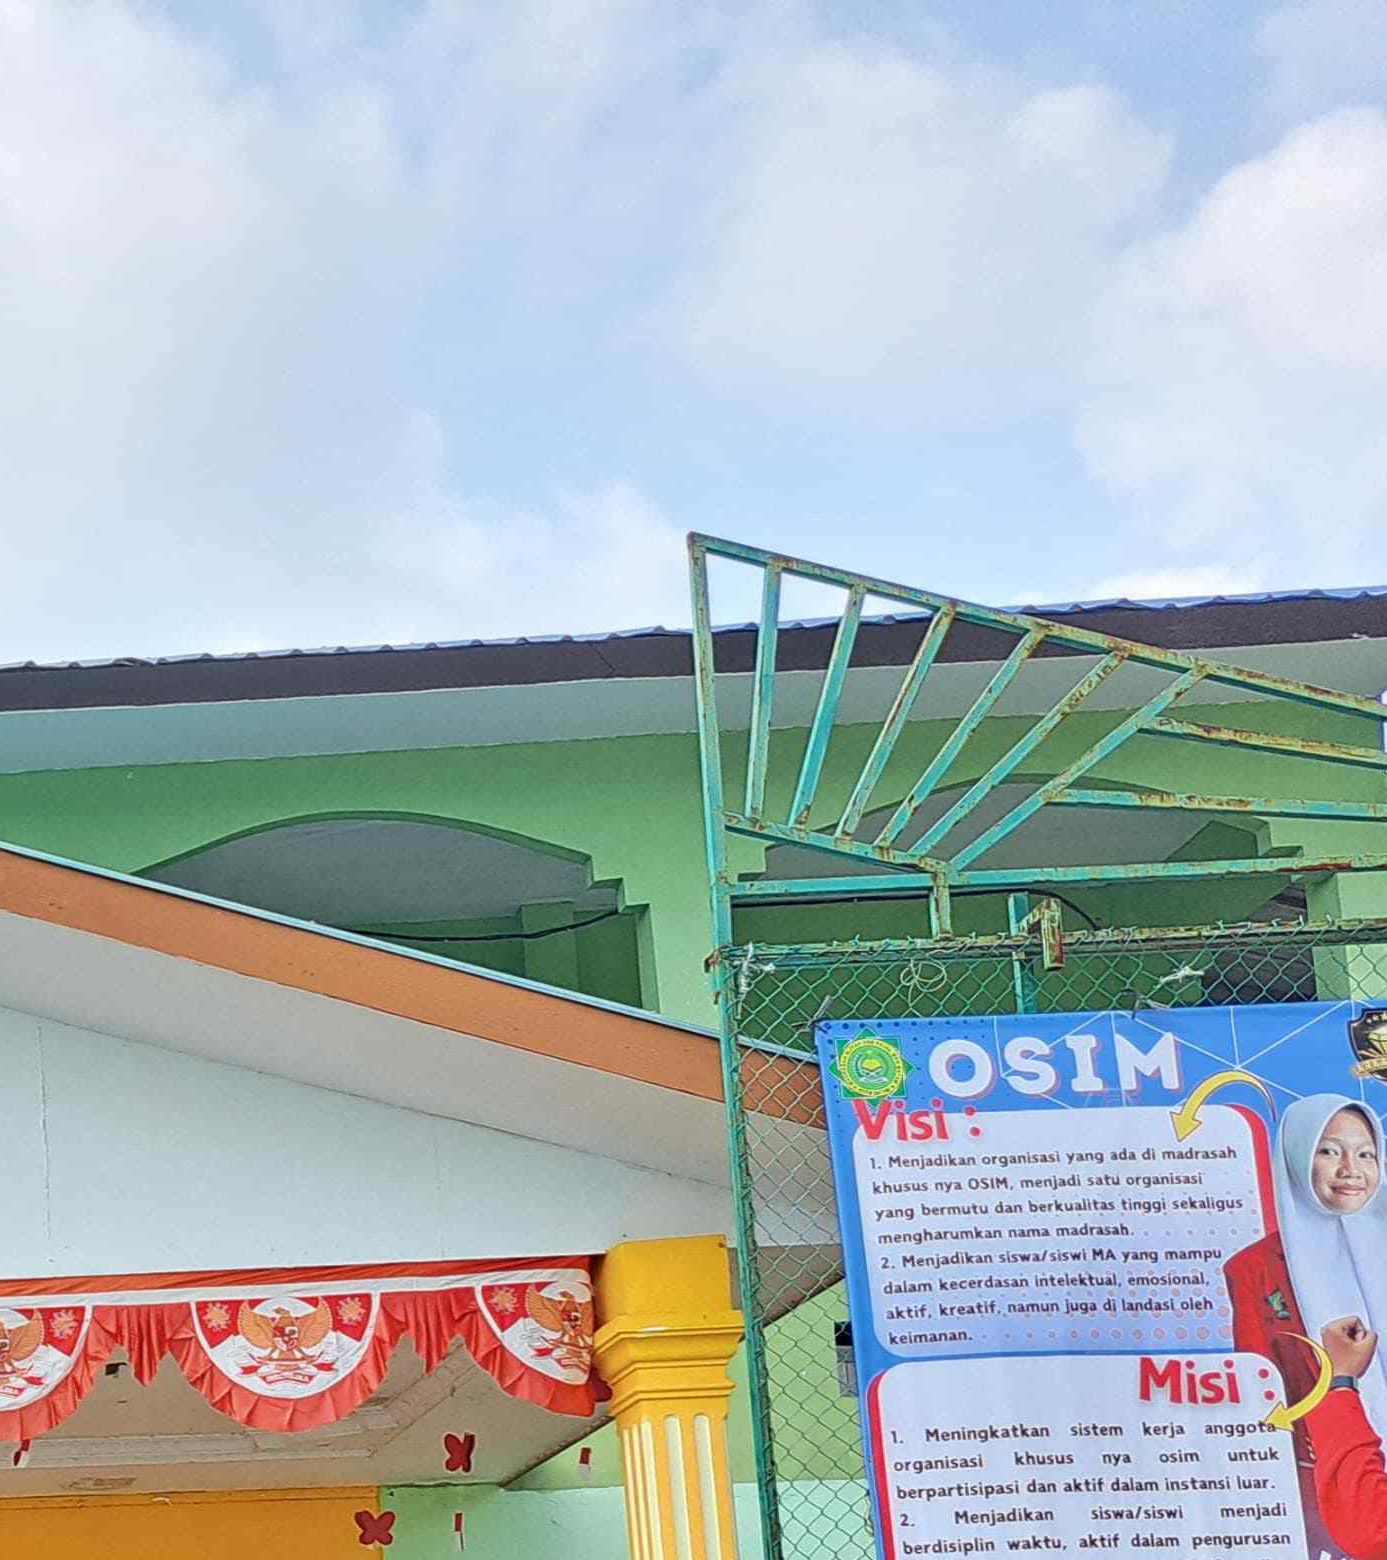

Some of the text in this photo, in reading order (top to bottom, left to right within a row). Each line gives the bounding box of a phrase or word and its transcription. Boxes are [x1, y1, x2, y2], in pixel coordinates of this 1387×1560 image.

[929, 1033, 1179, 1097] OSIM
[854, 1098, 949, 1142] Visi
[889, 1147, 1236, 1171] Menjadikan organisasi yang ada di madrasah
[873, 1181, 928, 1194] khusus
[935, 1180, 962, 1193] nya
[1020, 1174, 1081, 1190] menjadi
[1087, 1174, 1120, 1186] satu
[1126, 1173, 1203, 1188] organisasi
[876, 1198, 1243, 1221] yang bermutu dan berkualitas tinggi sekaligus
[878, 1227, 1002, 1245] mengharumkan
[1009, 1227, 1050, 1238] nama
[1139, 1357, 1241, 1404] Misi
[926, 1424, 1050, 1443] Meningkatkan
[1071, 1423, 1123, 1437] sistem
[1142, 1422, 1185, 1437] kerja
[903, 1532, 1290, 1555] berdisiplin waktu, aktif dalam pengurusan
